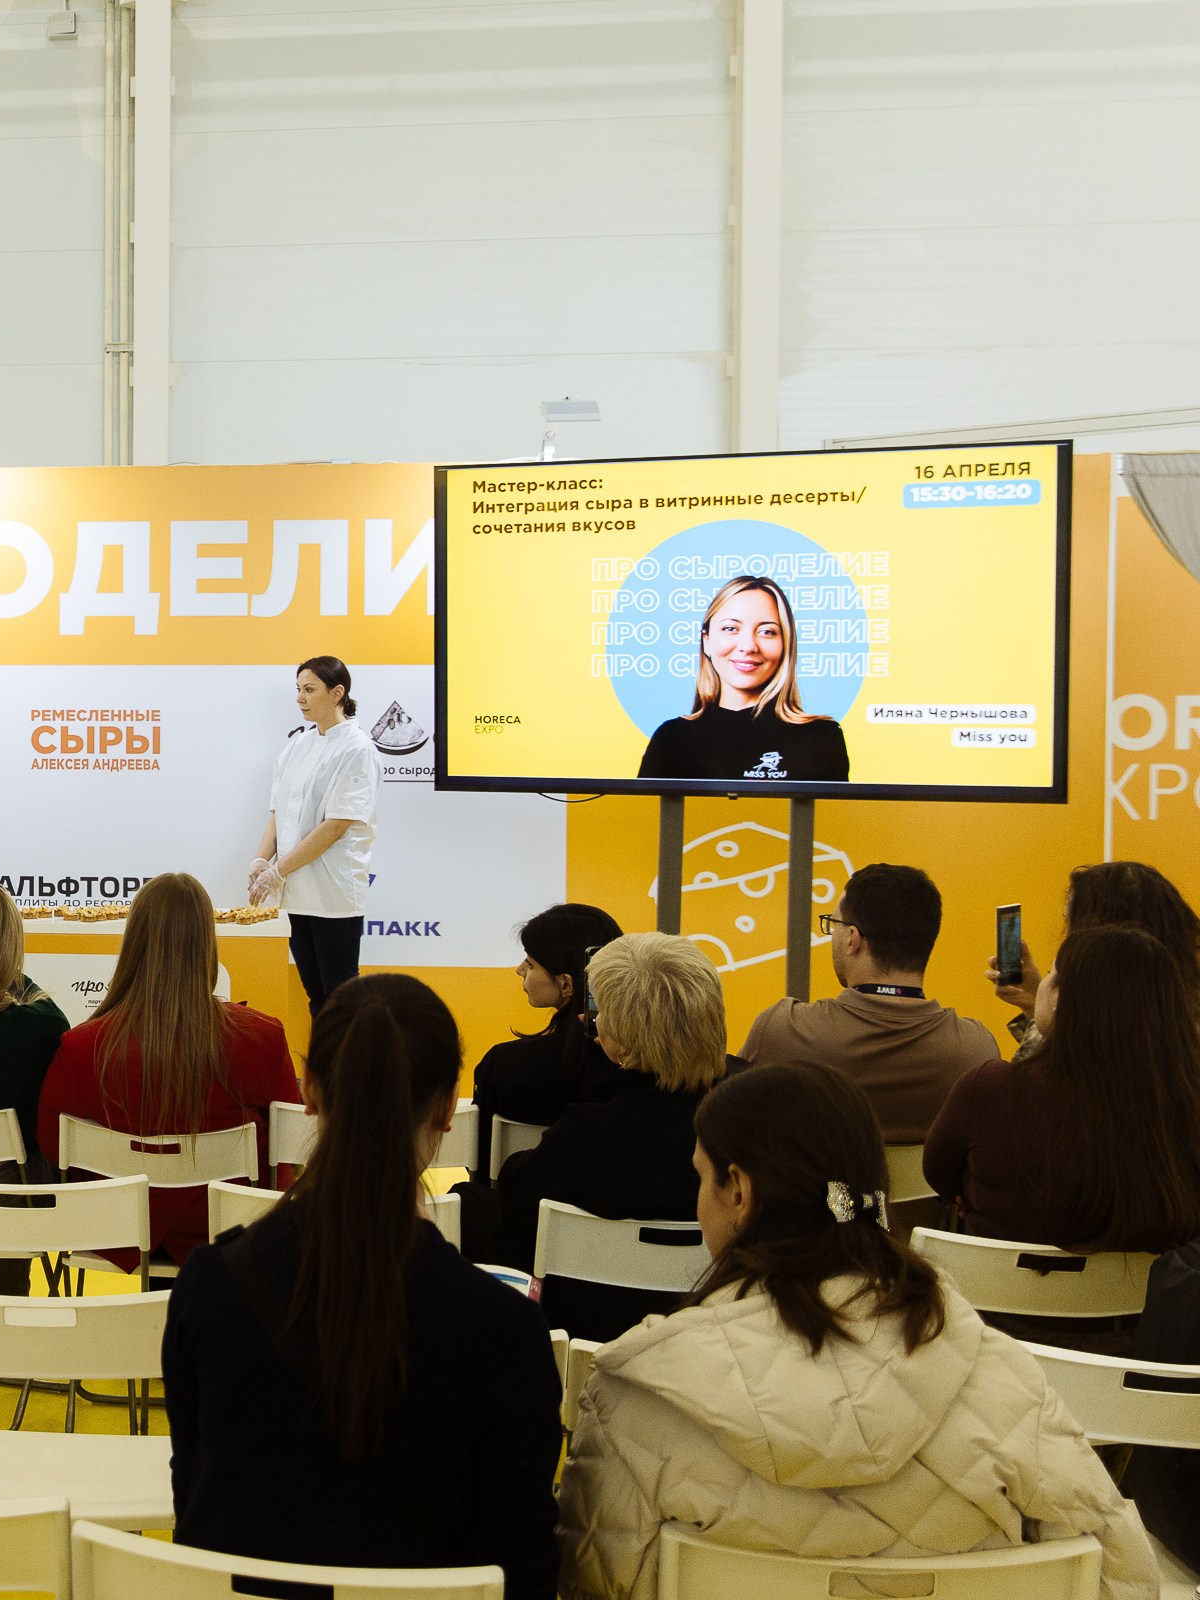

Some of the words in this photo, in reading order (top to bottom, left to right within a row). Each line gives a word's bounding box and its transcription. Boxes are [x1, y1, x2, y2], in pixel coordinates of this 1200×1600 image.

[914, 465, 935, 479] 16
[943, 461, 1032, 479] АПРЕЛЯ
[472, 478, 604, 495] Мастер-класс:
[910, 483, 1033, 504] 15:30-16:20
[472, 499, 580, 515] Интеграция
[585, 498, 633, 512] сыра
[639, 498, 649, 509] в
[655, 493, 764, 510] витринные
[770, 486, 868, 506] десерты/
[472, 522, 567, 535] сочетания
[571, 519, 637, 534] вкусов
[591, 556, 661, 582] ПРО
[667, 551, 891, 583] СЫРОДЕЛИЕ
[591, 588, 661, 614] ПРО
[591, 620, 661, 646] ПРО
[591, 652, 661, 678] ПРО
[30, 709, 161, 722] РЕМЕСЛЕННЫЕ
[474, 715, 521, 724] HORECA
[874, 707, 923, 719] Иляна
[928, 707, 1028, 720] Чернышова
[474, 725, 504, 734] EXPO
[959, 731, 992, 742] Miss
[999, 734, 1027, 744] you
[30, 725, 161, 755] СЫРЫ
[31, 758, 89, 771] АЛЕКСЕЯ
[92, 758, 161, 773] АНДРЕЕВА
[743, 770, 766, 778] MISS
[767, 770, 788, 778] YOU
[876, 986, 896, 995] BWT
